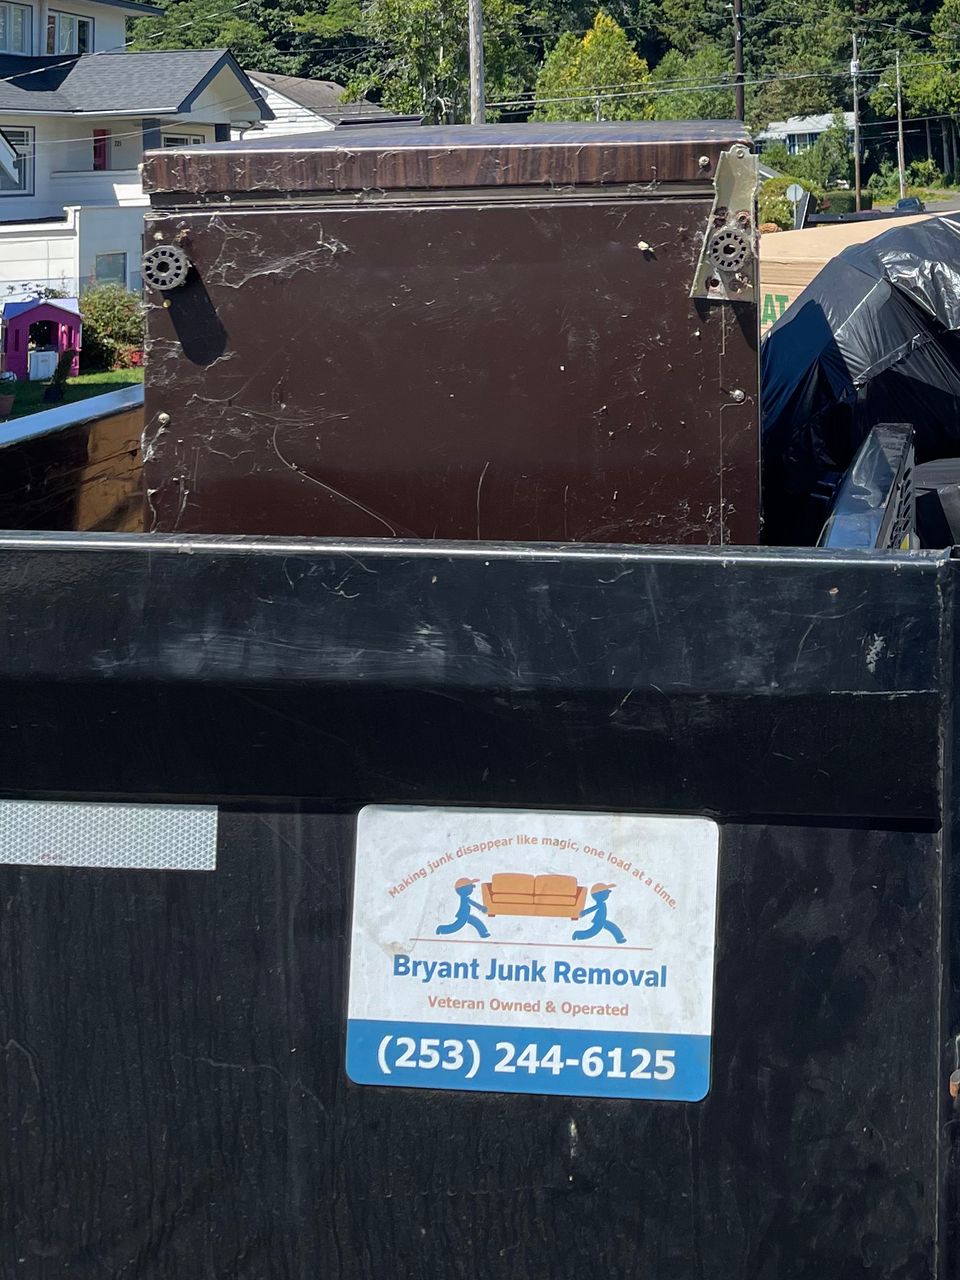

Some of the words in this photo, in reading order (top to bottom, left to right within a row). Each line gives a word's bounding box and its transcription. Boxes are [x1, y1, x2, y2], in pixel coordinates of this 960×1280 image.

[388, 867, 427, 898] Making
[427, 852, 454, 874] junk
[456, 838, 513, 858] disappear
[517, 835, 538, 845] like
[541, 837, 580, 852] magic,
[583, 845, 605, 859] one
[607, 852, 632, 871] load
[632, 869, 646, 881] at
[645, 877, 653, 886] a
[653, 883, 678, 910] time.
[393, 953, 480, 984] Bryant
[485, 958, 546, 984] Junk
[553, 961, 668, 988] Removal
[427, 995, 485, 1011] Veteran
[489, 997, 541, 1013] Owned
[545, 1000, 557, 1014] &
[561, 1001, 629, 1017] Operated
[377, 1034, 481, 1079] (253)
[494, 1041, 677, 1081] 244-6125
